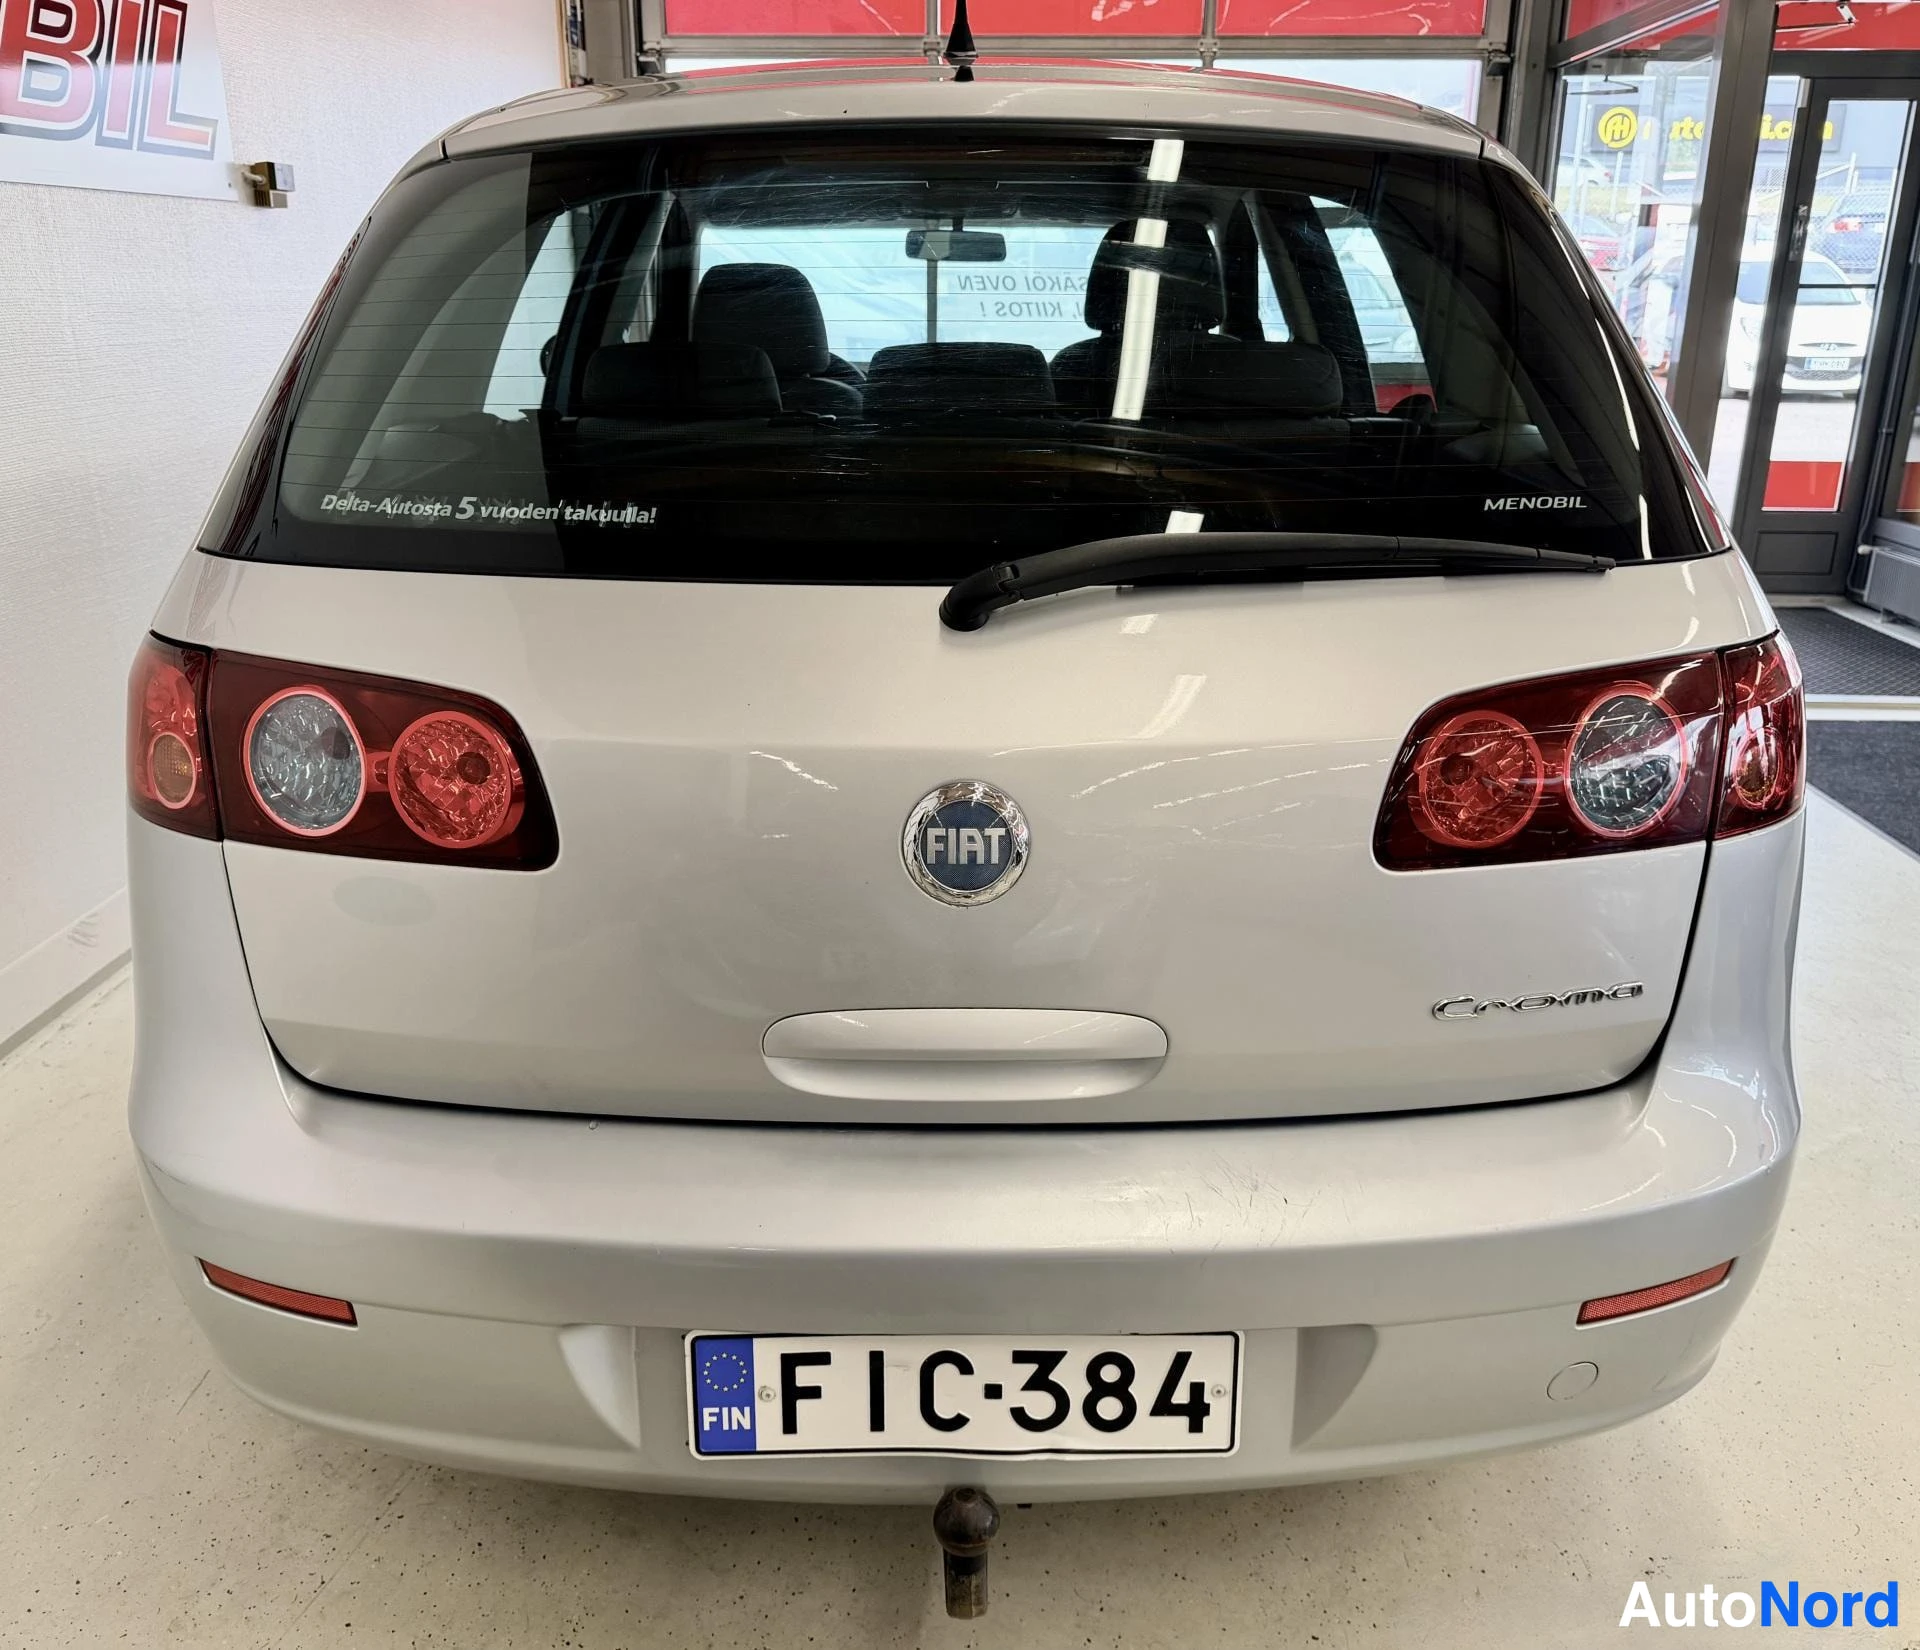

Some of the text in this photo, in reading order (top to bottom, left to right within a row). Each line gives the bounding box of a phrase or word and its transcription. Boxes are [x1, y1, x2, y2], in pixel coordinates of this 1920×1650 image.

[0, 0, 218, 160] BIL
[319, 494, 658, 524] Delta-Autosta 5 vuoden takuulla!
[1483, 496, 1588, 511] MENOBIL
[926, 827, 1006, 865] FIAT
[1432, 981, 1644, 1021] Croma
[779, 1349, 1212, 1436] FIC-384
[702, 1406, 752, 1432] FIN
